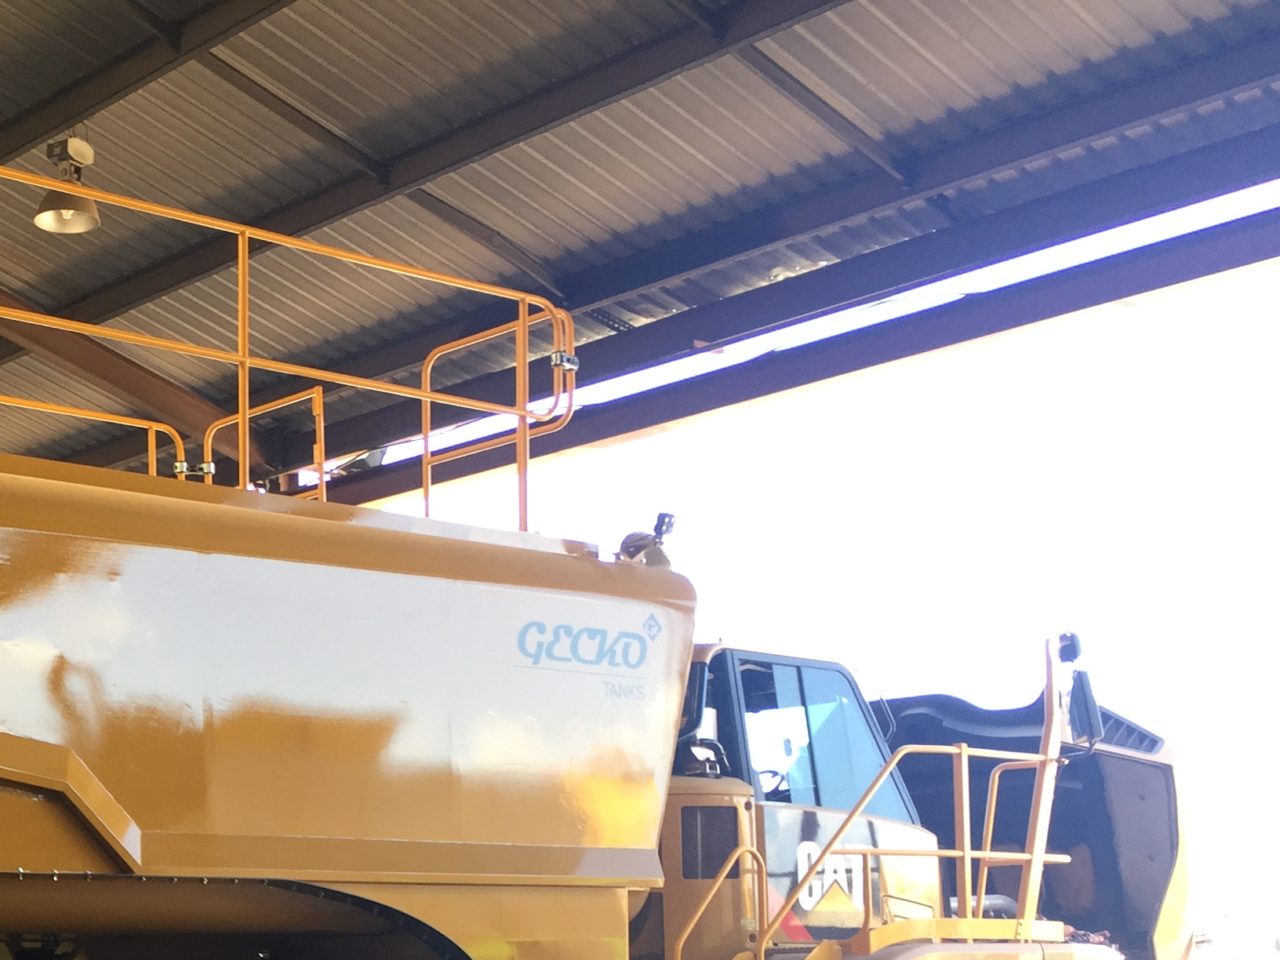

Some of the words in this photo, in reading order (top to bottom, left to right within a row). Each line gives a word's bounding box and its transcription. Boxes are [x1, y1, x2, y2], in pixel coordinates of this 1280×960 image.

[517, 621, 647, 669] GECKO
[602, 681, 645, 700] TANKS
[797, 841, 872, 912] CAT
